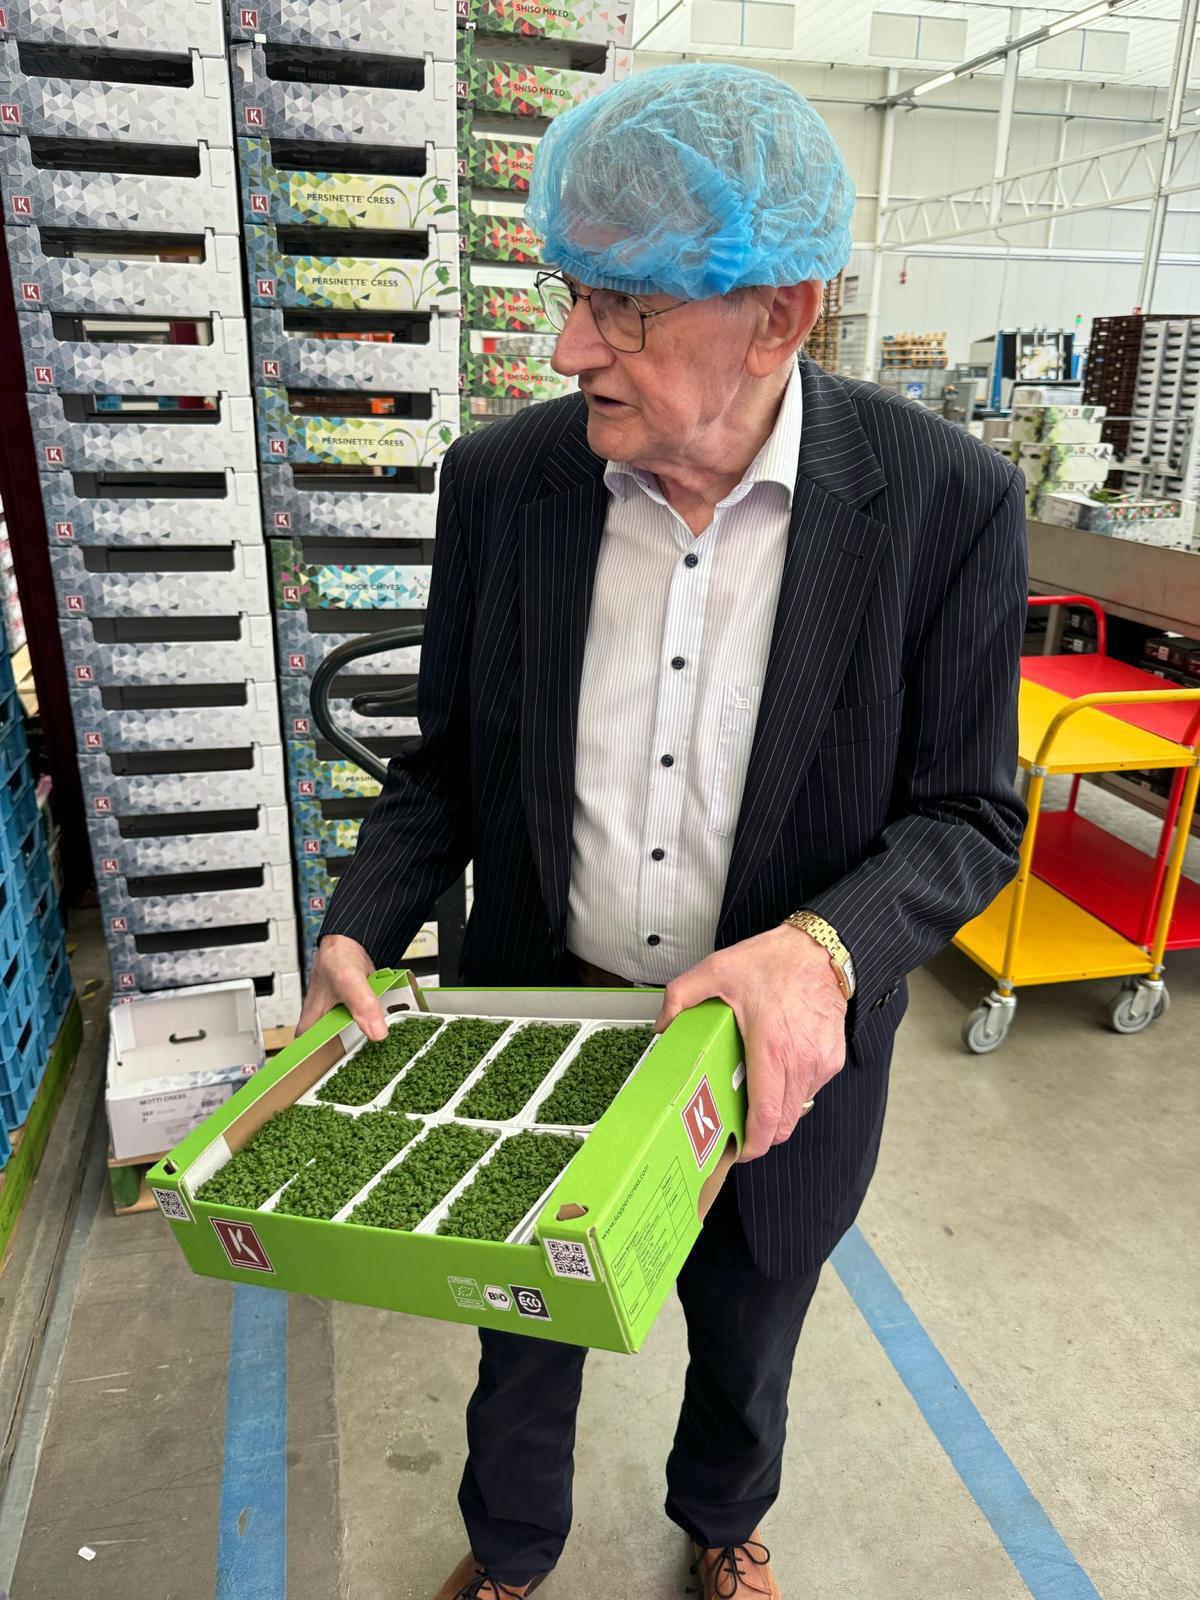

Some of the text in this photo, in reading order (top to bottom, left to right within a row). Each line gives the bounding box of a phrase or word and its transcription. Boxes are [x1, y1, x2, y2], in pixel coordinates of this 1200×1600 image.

[516, 4, 569, 18] SHISO MIXED
[513, 83, 566, 97] SHISO MIXED
[366, 195, 396, 205] CRESS
[371, 278, 399, 288] CRESS
[377, 439, 405, 447] CRESS
